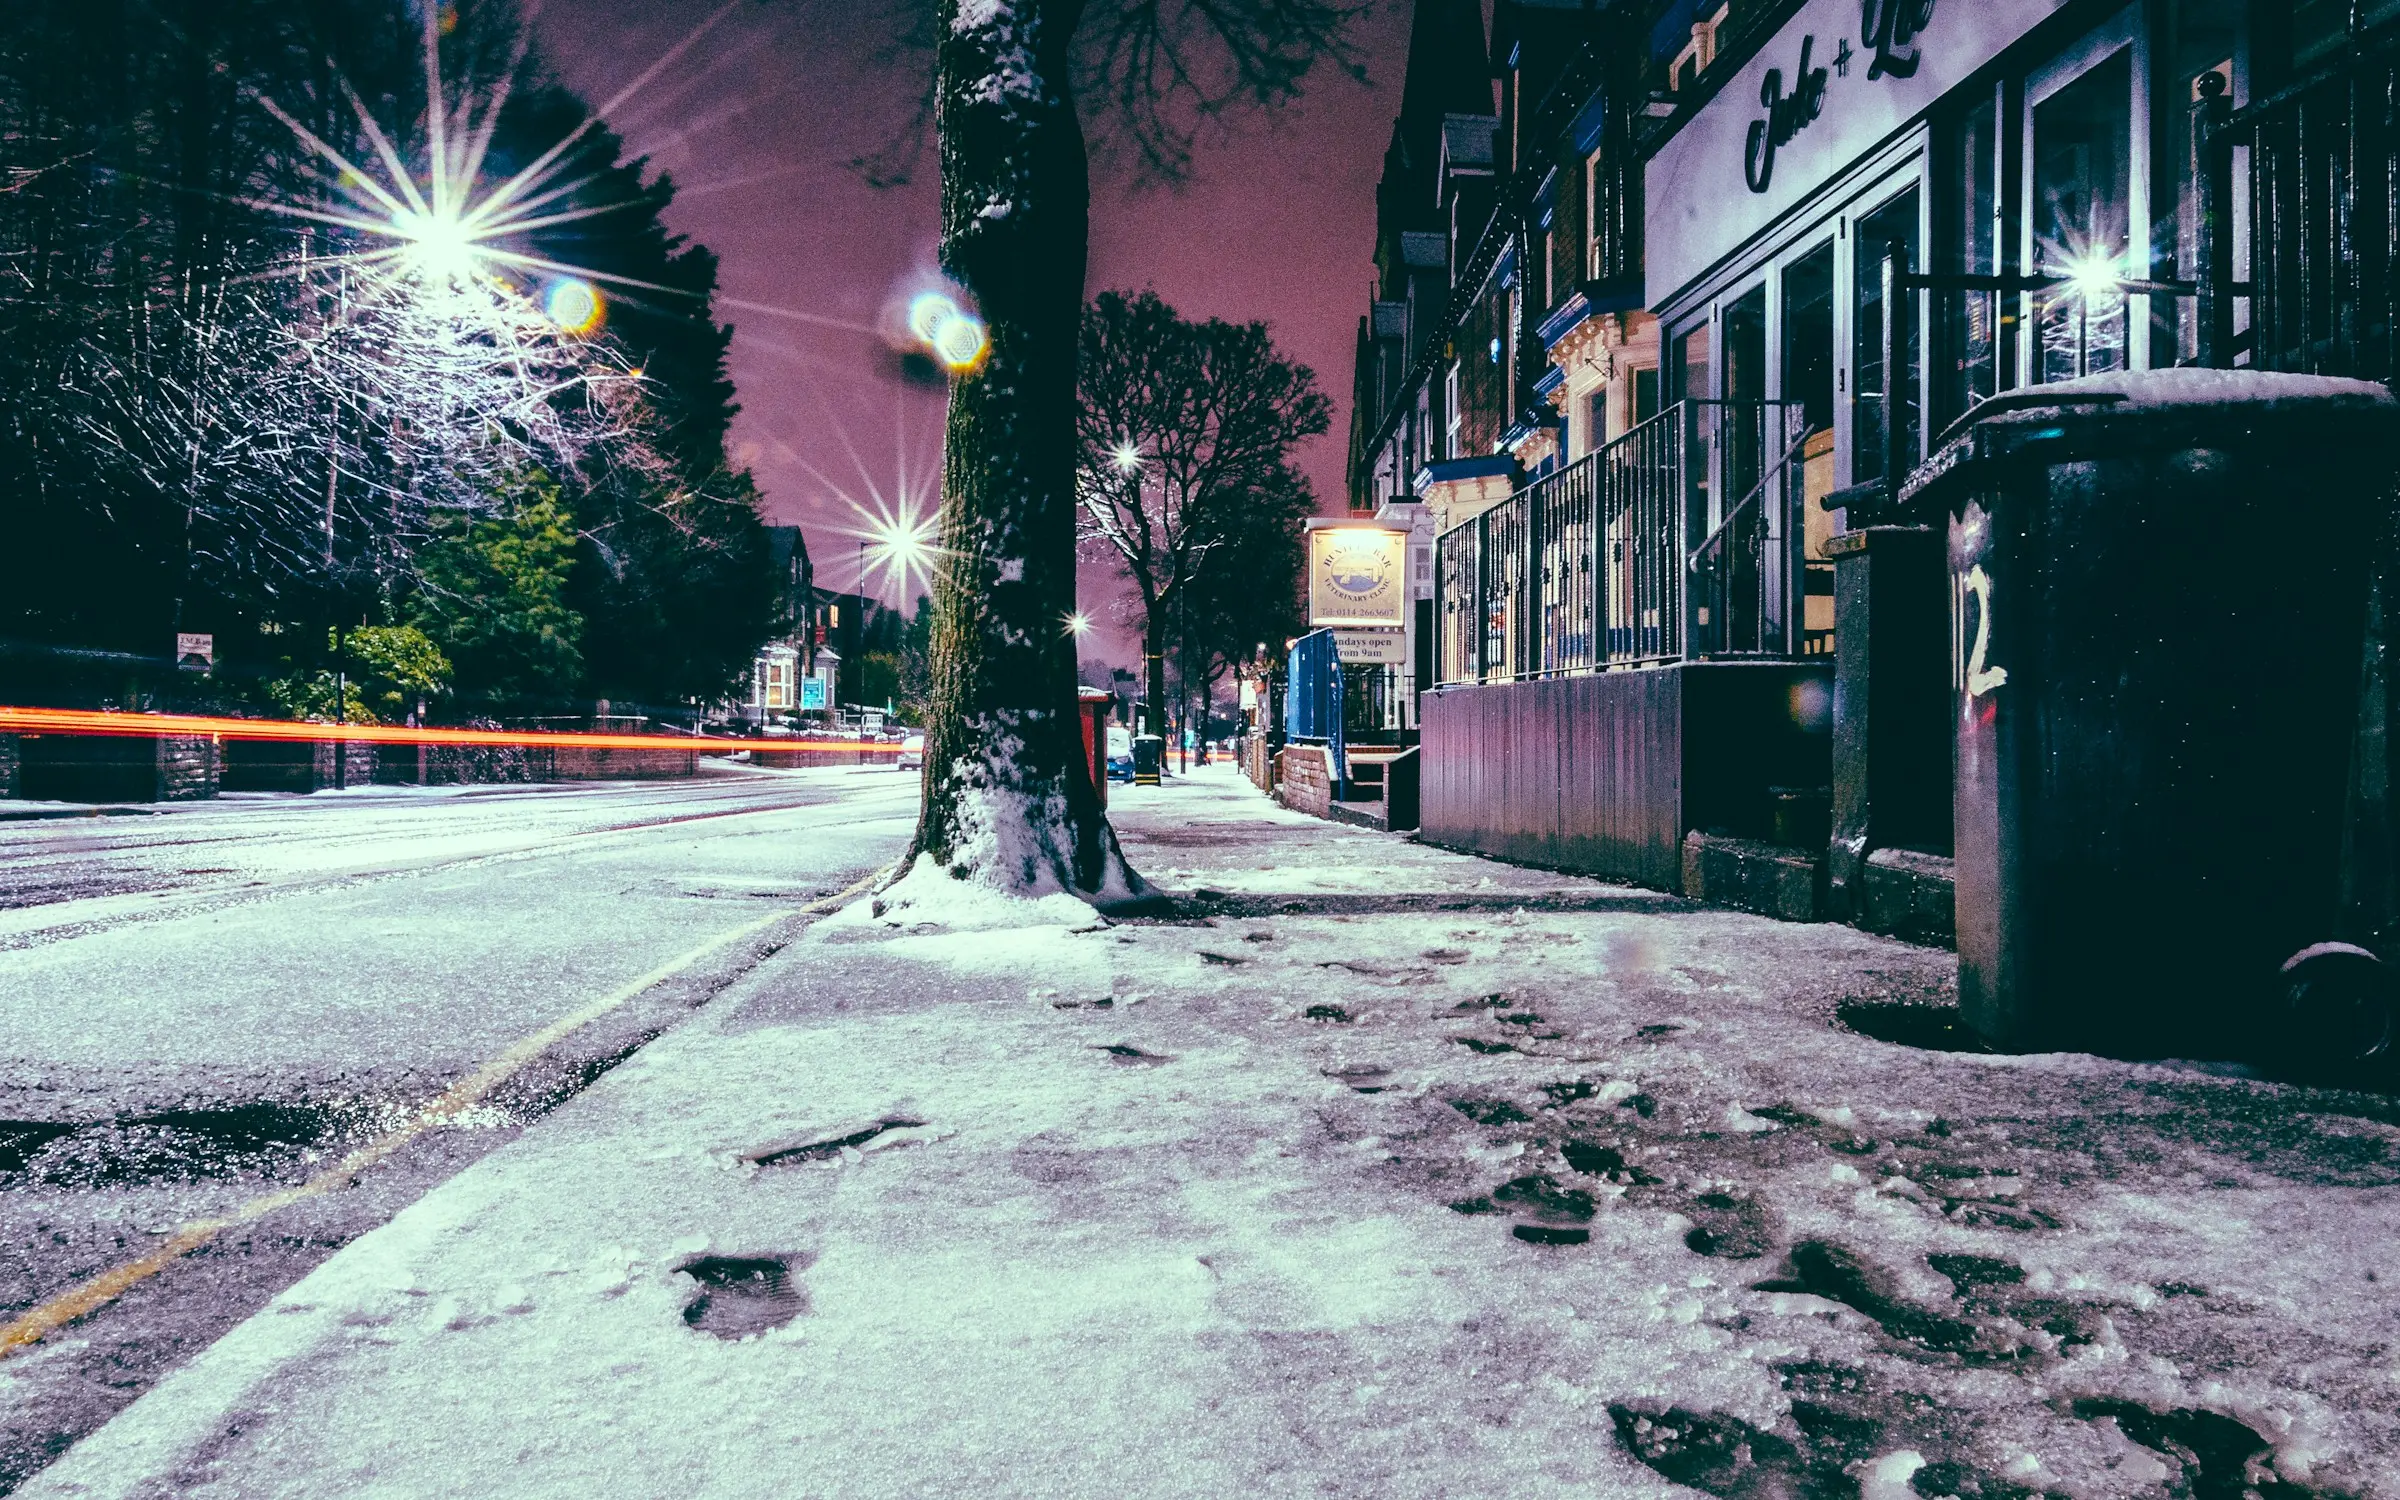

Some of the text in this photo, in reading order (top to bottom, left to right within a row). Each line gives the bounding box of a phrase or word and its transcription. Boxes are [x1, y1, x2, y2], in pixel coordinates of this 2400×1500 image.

[1324, 577, 1391, 602] VETERINARY CLINIC
[1336, 607, 1357, 617] 0114
[1334, 637, 1392, 649] undays open
[1337, 648, 1383, 657] rom 9am
